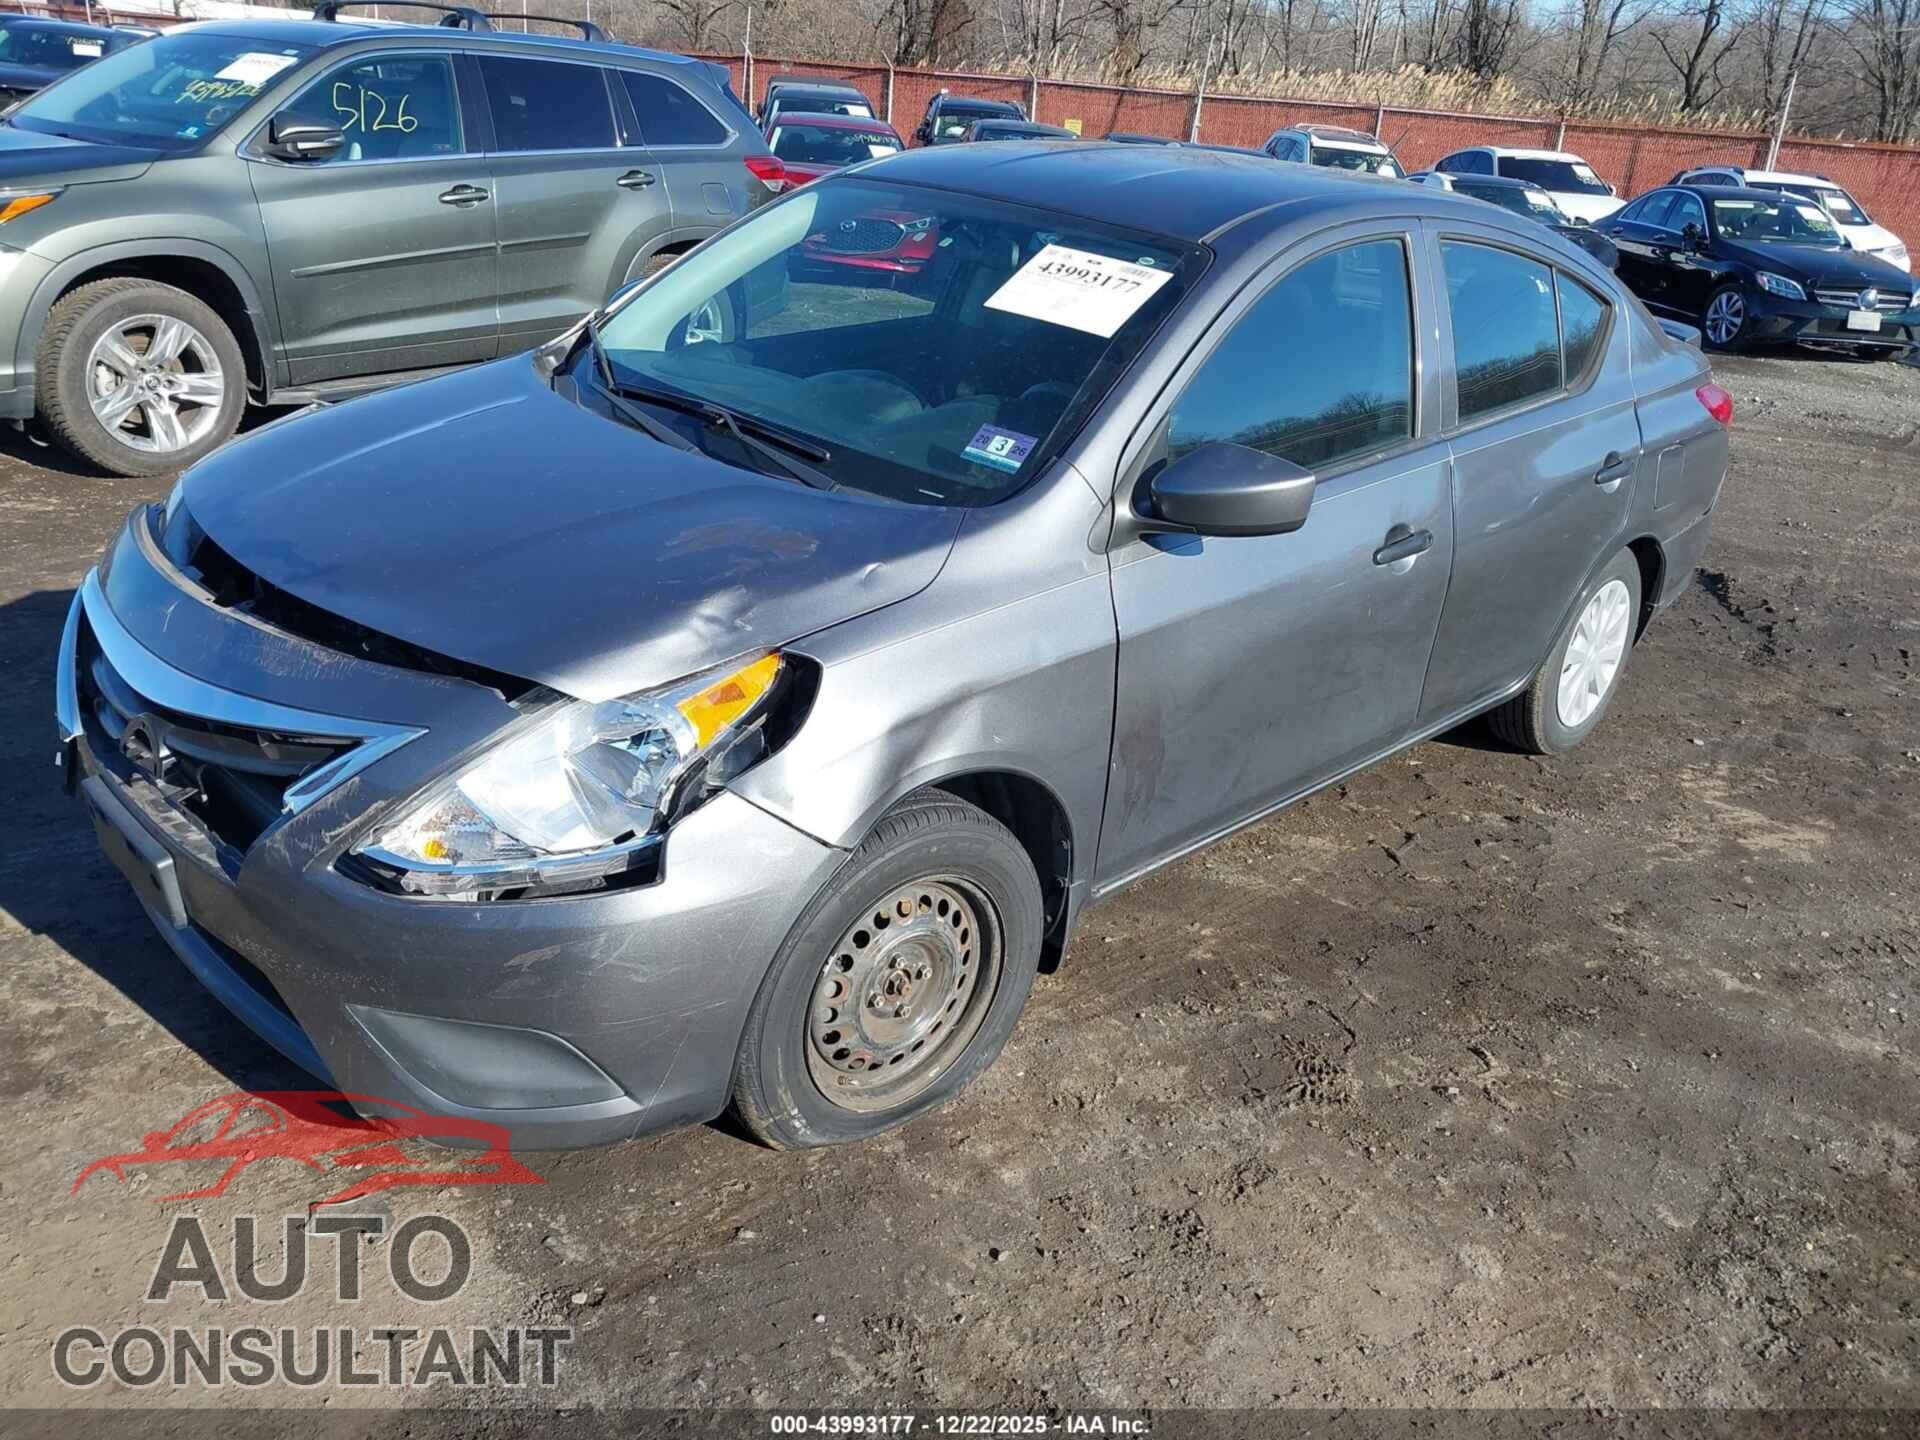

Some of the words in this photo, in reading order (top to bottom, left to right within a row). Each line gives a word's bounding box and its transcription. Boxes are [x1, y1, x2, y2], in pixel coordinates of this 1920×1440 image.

[333, 83, 417, 132] 5126
[1039, 261, 1141, 293] 43993177
[995, 439, 1009, 452] 3
